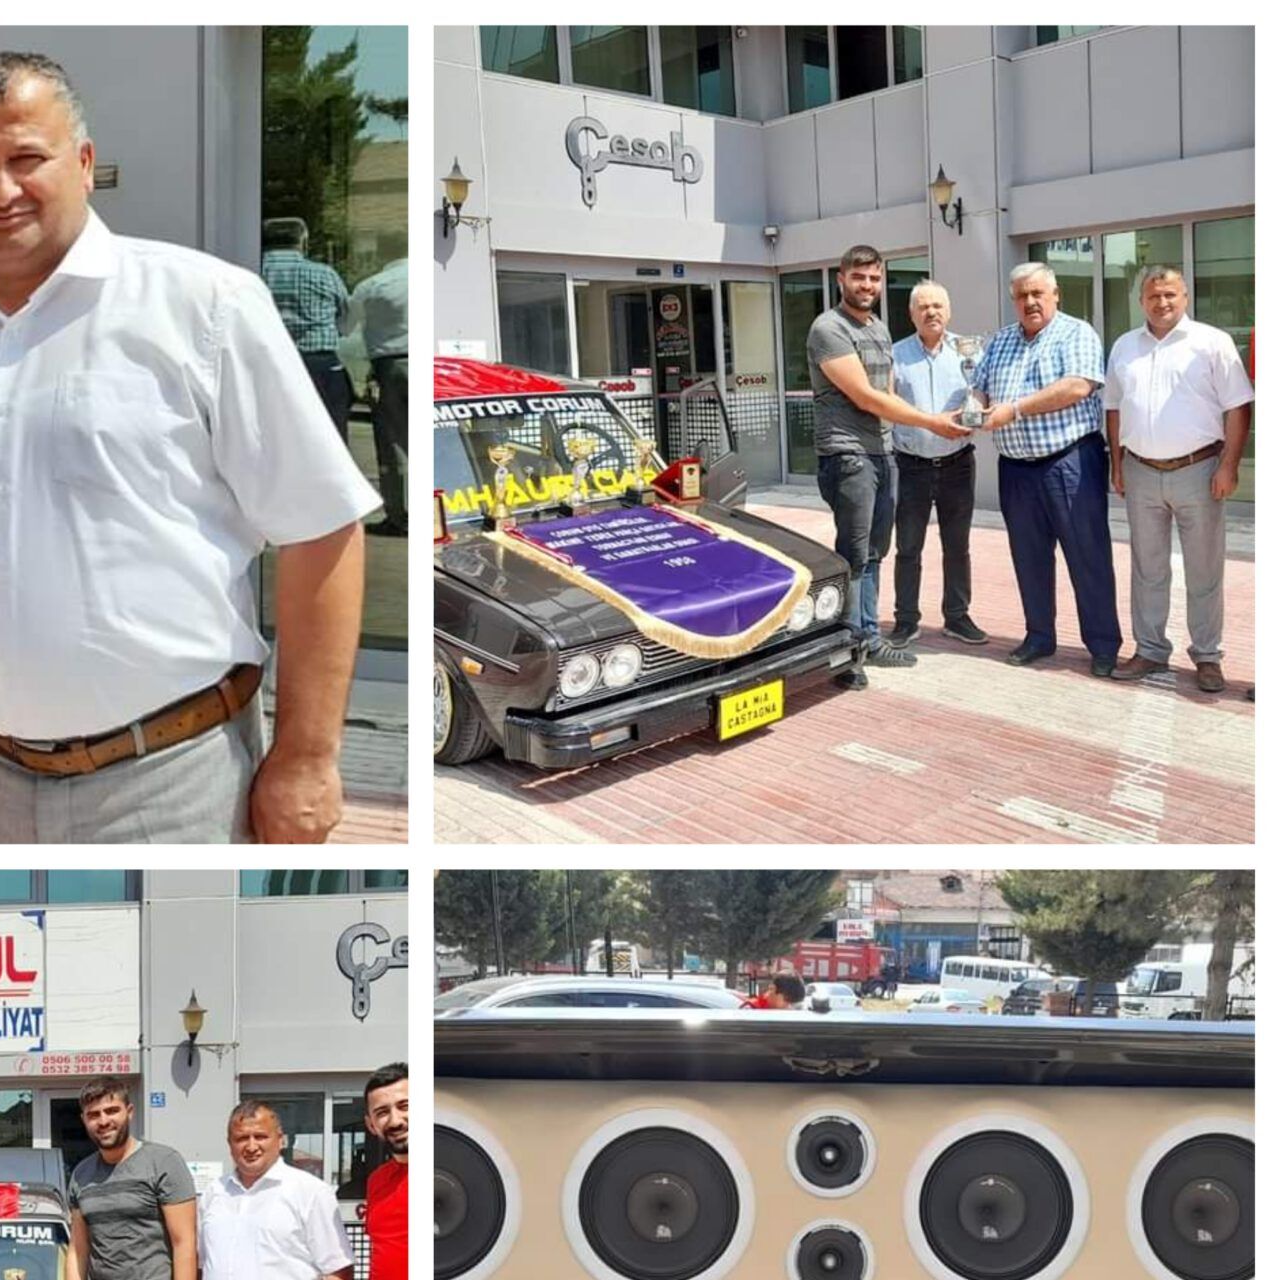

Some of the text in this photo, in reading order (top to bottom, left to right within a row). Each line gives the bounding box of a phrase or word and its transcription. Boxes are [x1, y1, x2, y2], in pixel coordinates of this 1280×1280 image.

[565, 116, 704, 211] Çesob
[735, 700, 749, 713] LA
[727, 702, 777, 730] CASTAGNA
[41, 1054, 131, 1065] 0506 500 00 58
[41, 1064, 131, 1074] 0532 385 74 98
